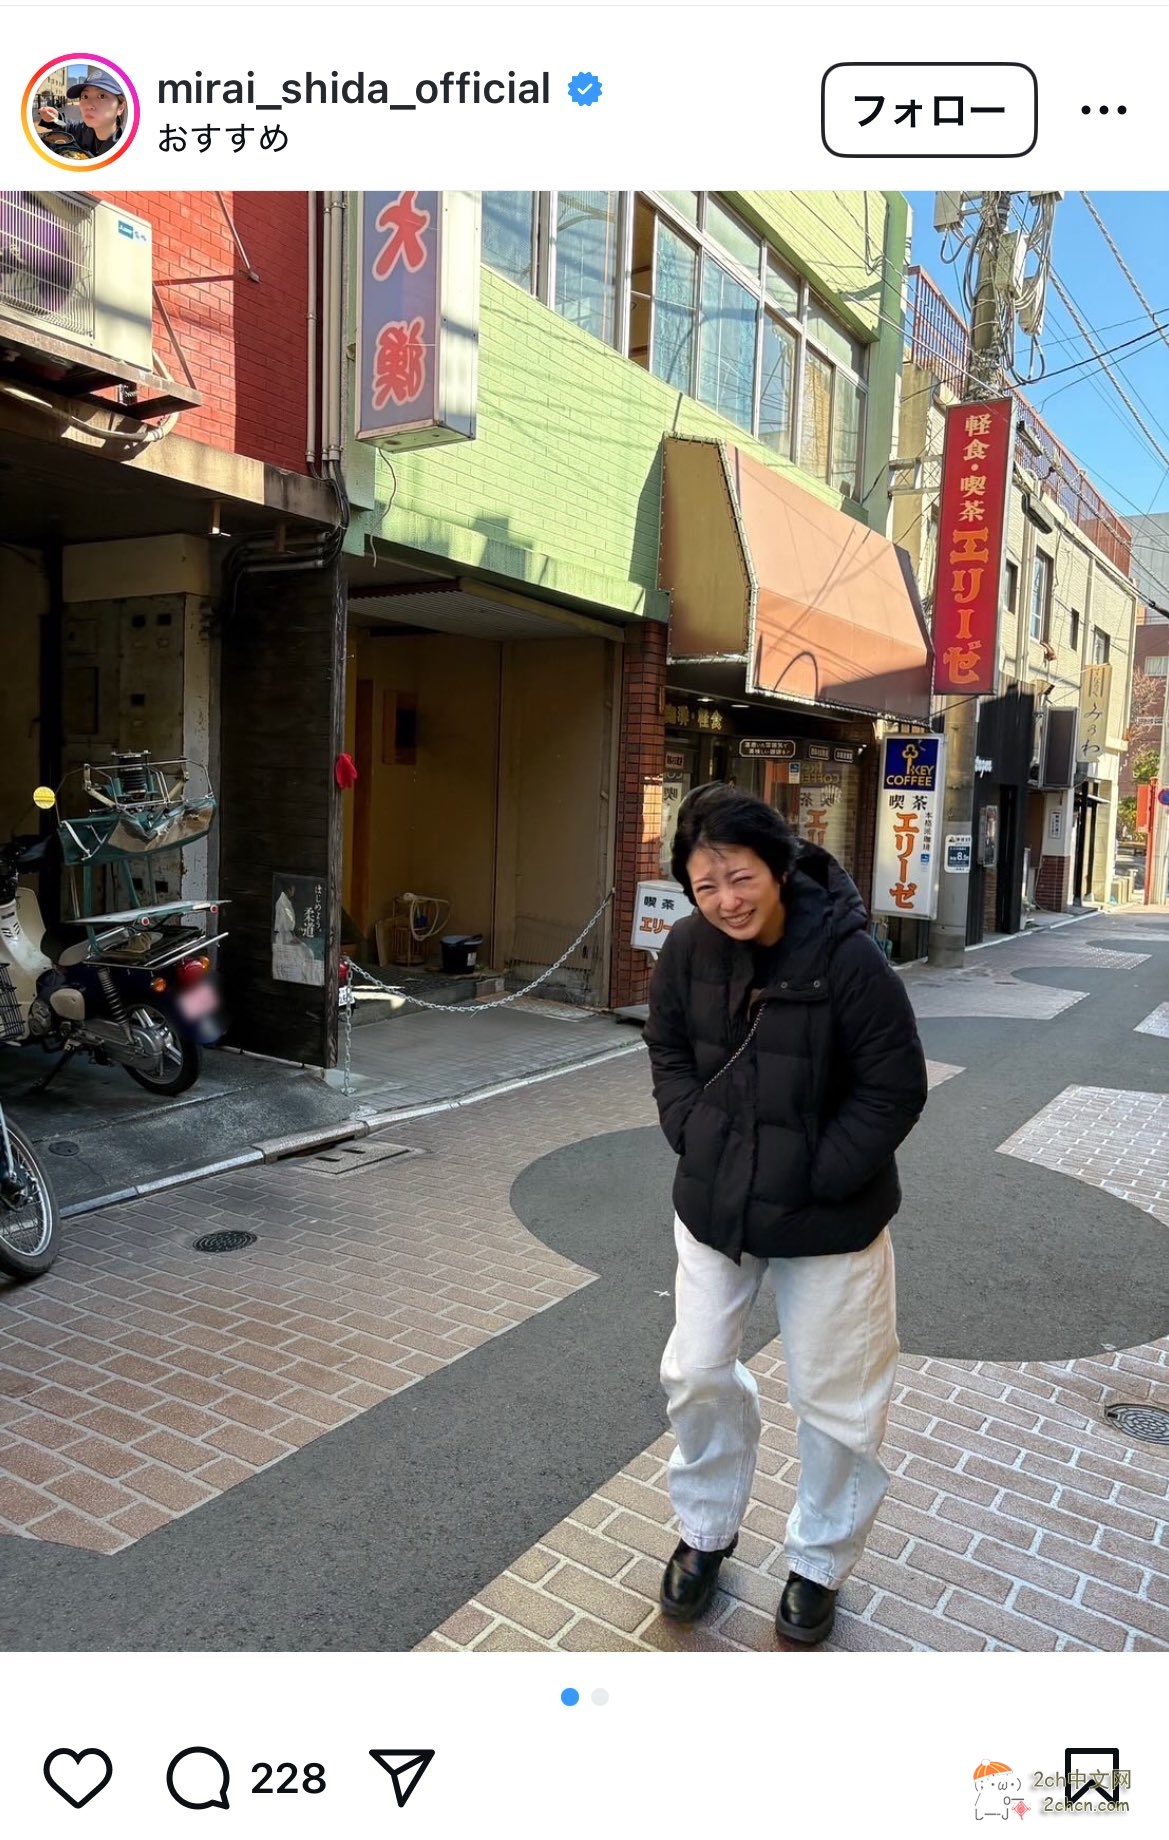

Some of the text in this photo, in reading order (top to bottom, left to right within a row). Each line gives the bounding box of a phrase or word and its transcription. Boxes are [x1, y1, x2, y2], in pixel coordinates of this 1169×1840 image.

[959, 412, 993, 522] 軽食・喫茶
[942, 527, 989, 684] エリーゼ
[910, 765, 935, 775] KEY
[886, 774, 932, 787] COFFEE
[888, 794, 928, 811] 喫茶
[889, 812, 920, 909] エリーゼ
[643, 896, 675, 910] 喫茶
